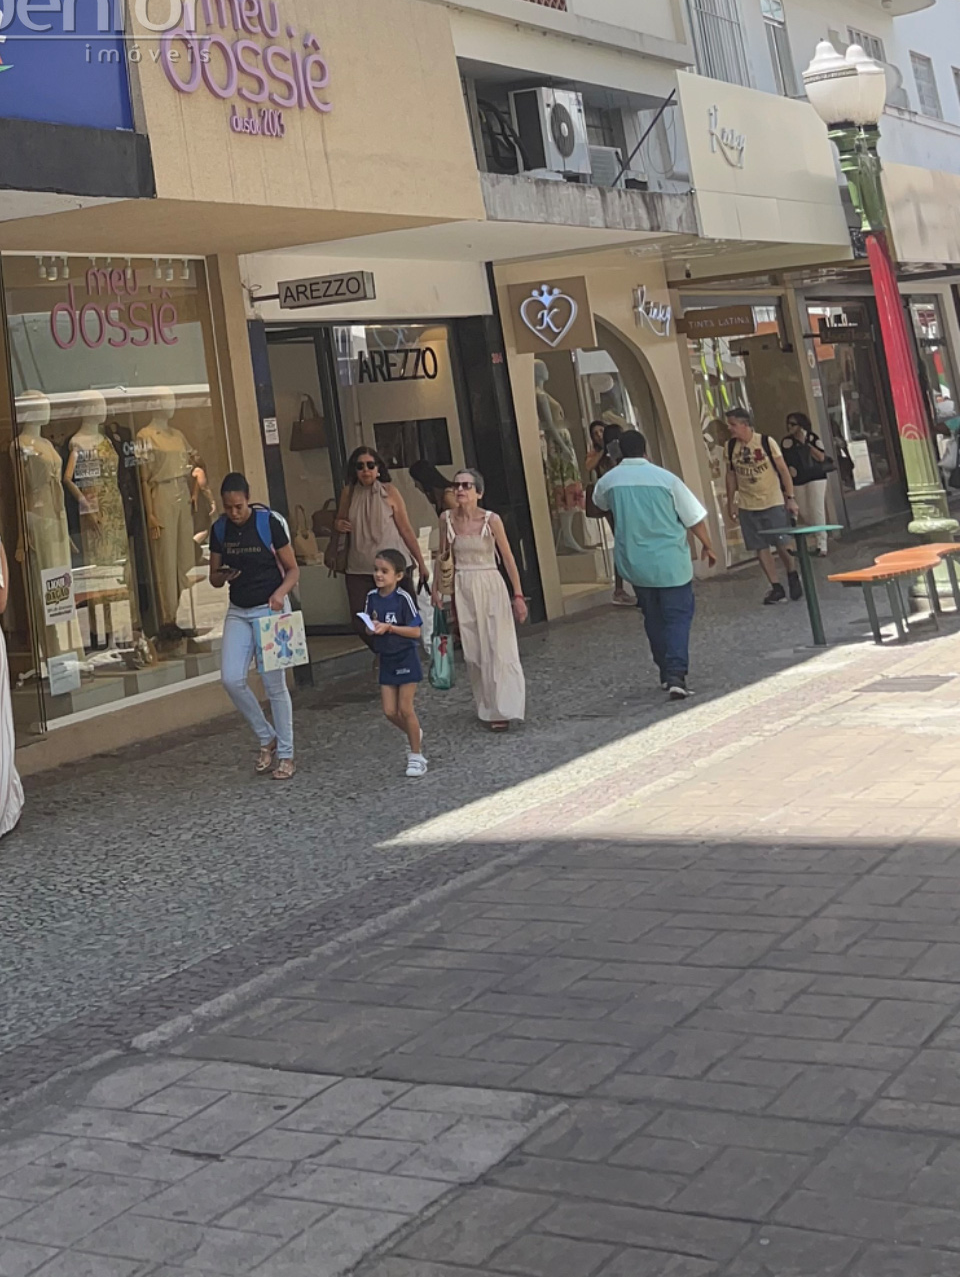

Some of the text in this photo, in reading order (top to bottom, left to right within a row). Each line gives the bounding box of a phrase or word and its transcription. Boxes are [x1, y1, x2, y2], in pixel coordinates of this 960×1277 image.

[160, 2, 333, 113] dossiê
[85, 267, 139, 296] meu
[282, 275, 362, 304] AREZZO
[50, 282, 179, 350] dossiê
[535, 307, 562, 333] K
[357, 346, 439, 384] AREZZO
